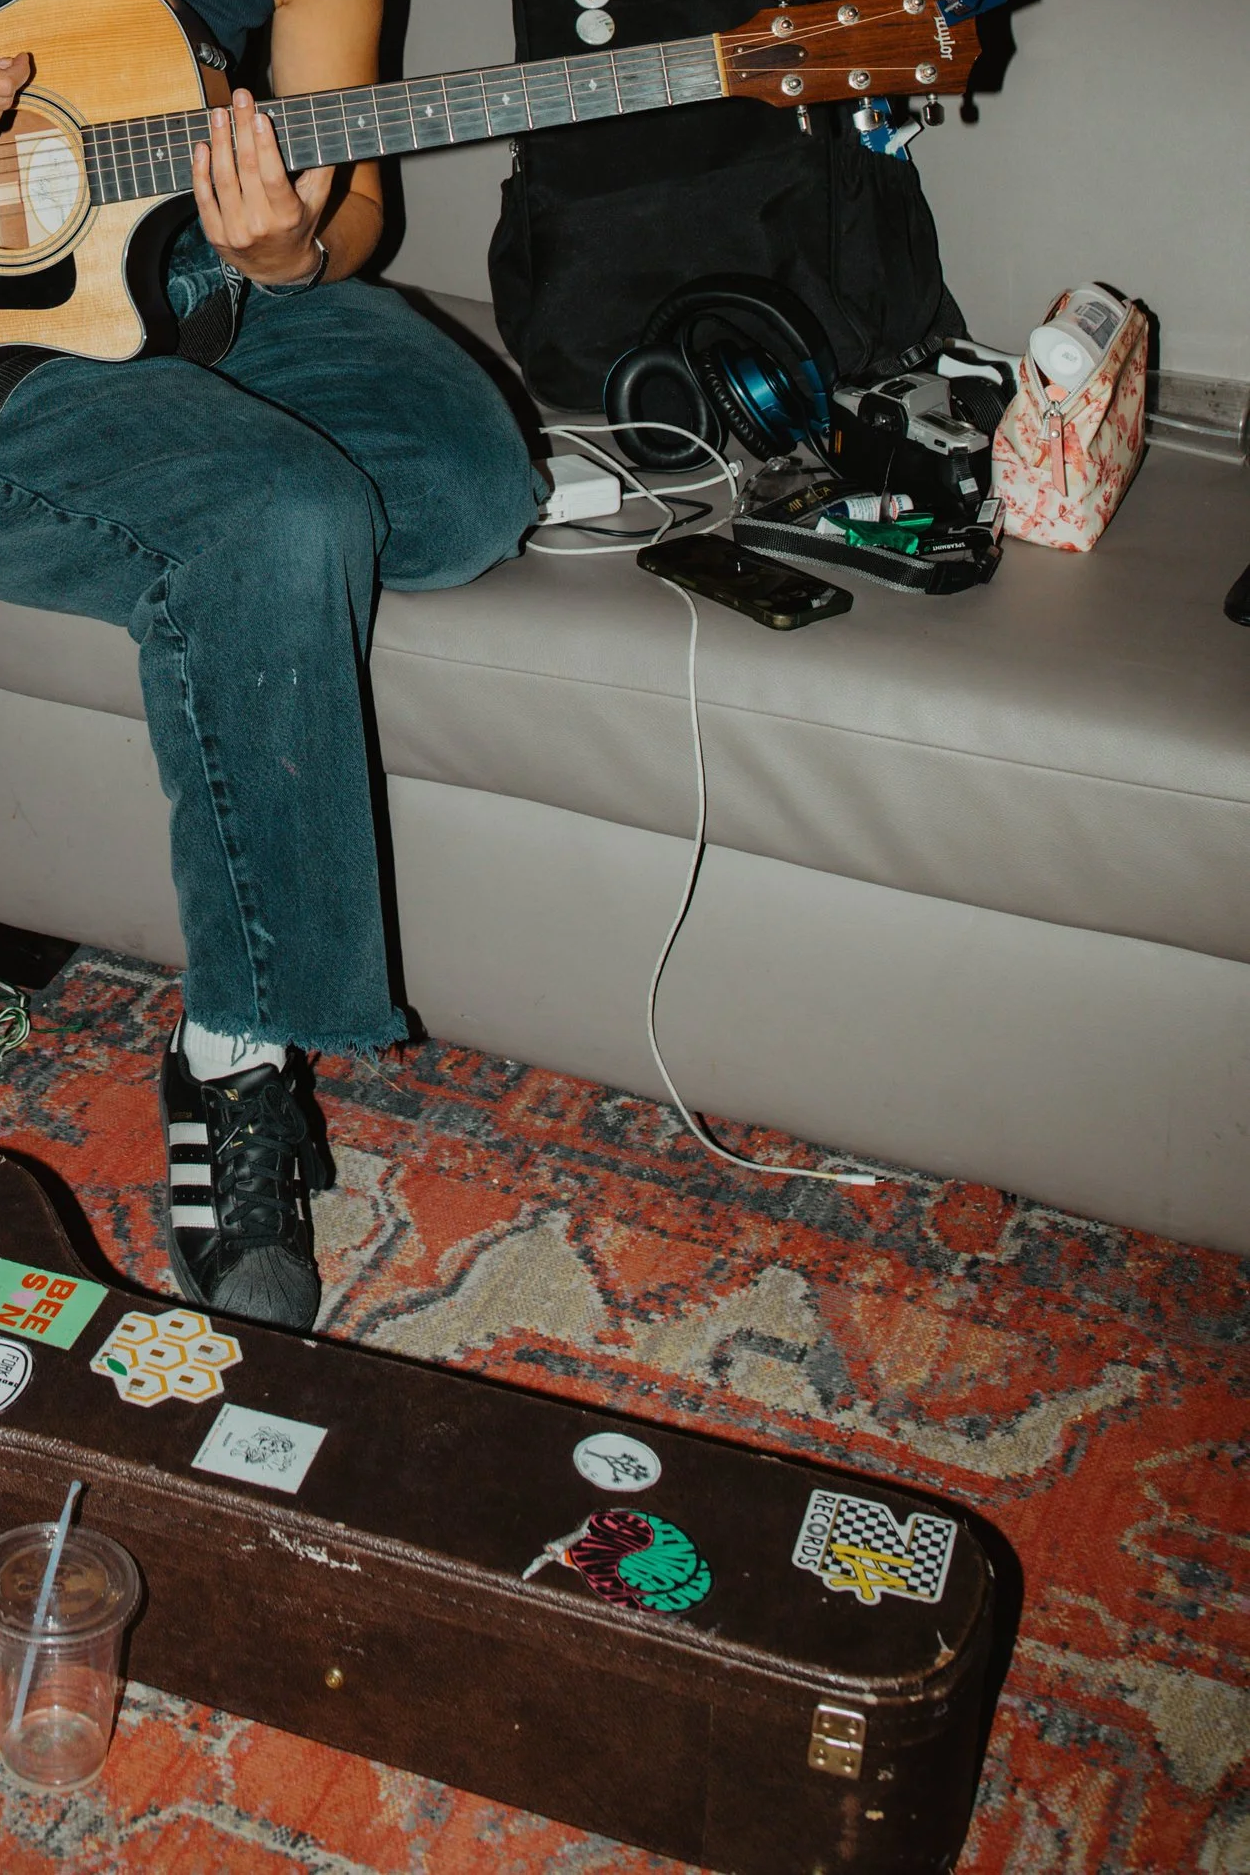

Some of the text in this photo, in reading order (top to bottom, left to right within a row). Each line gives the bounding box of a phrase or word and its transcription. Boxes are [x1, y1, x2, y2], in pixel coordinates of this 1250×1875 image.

[19, 1278, 78, 1335] BEE
[617, 1513, 698, 1593] VINTAGE
[797, 1492, 837, 1569] RECORDS
